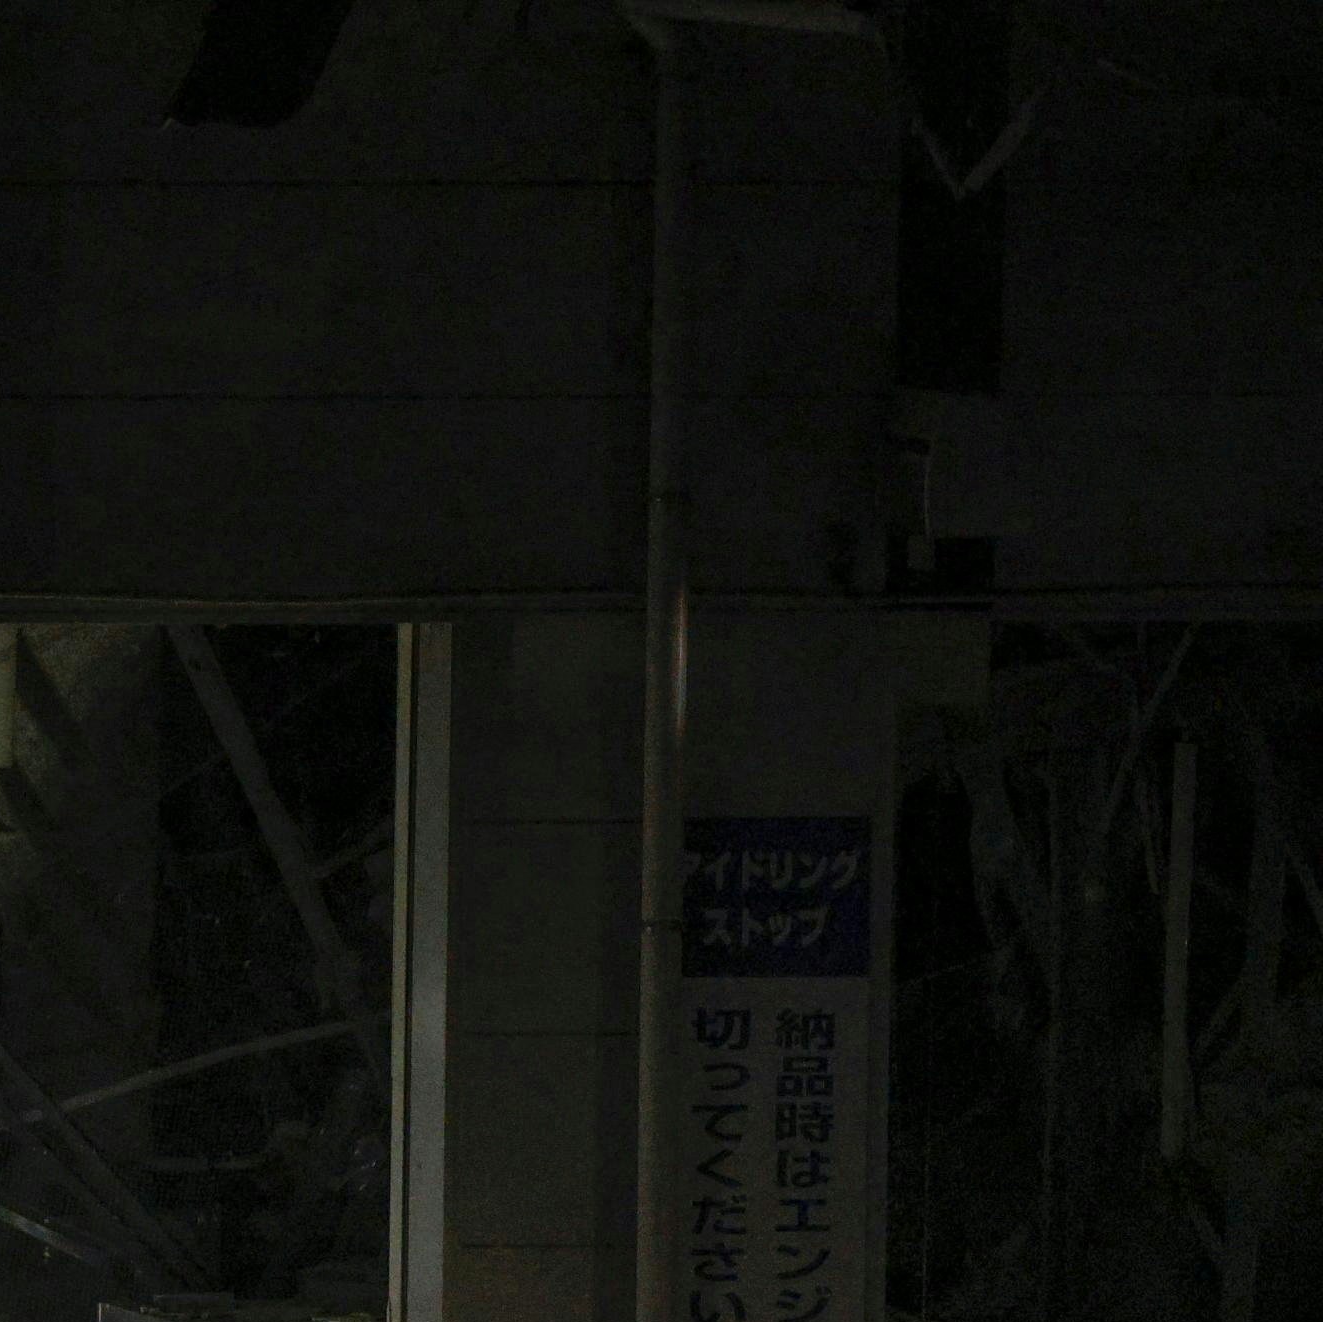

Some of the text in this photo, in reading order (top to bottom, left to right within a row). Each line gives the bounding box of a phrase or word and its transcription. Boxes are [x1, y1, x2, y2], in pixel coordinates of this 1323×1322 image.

[681, 847, 857, 893] イドリング
[702, 906, 836, 949] ストップ
